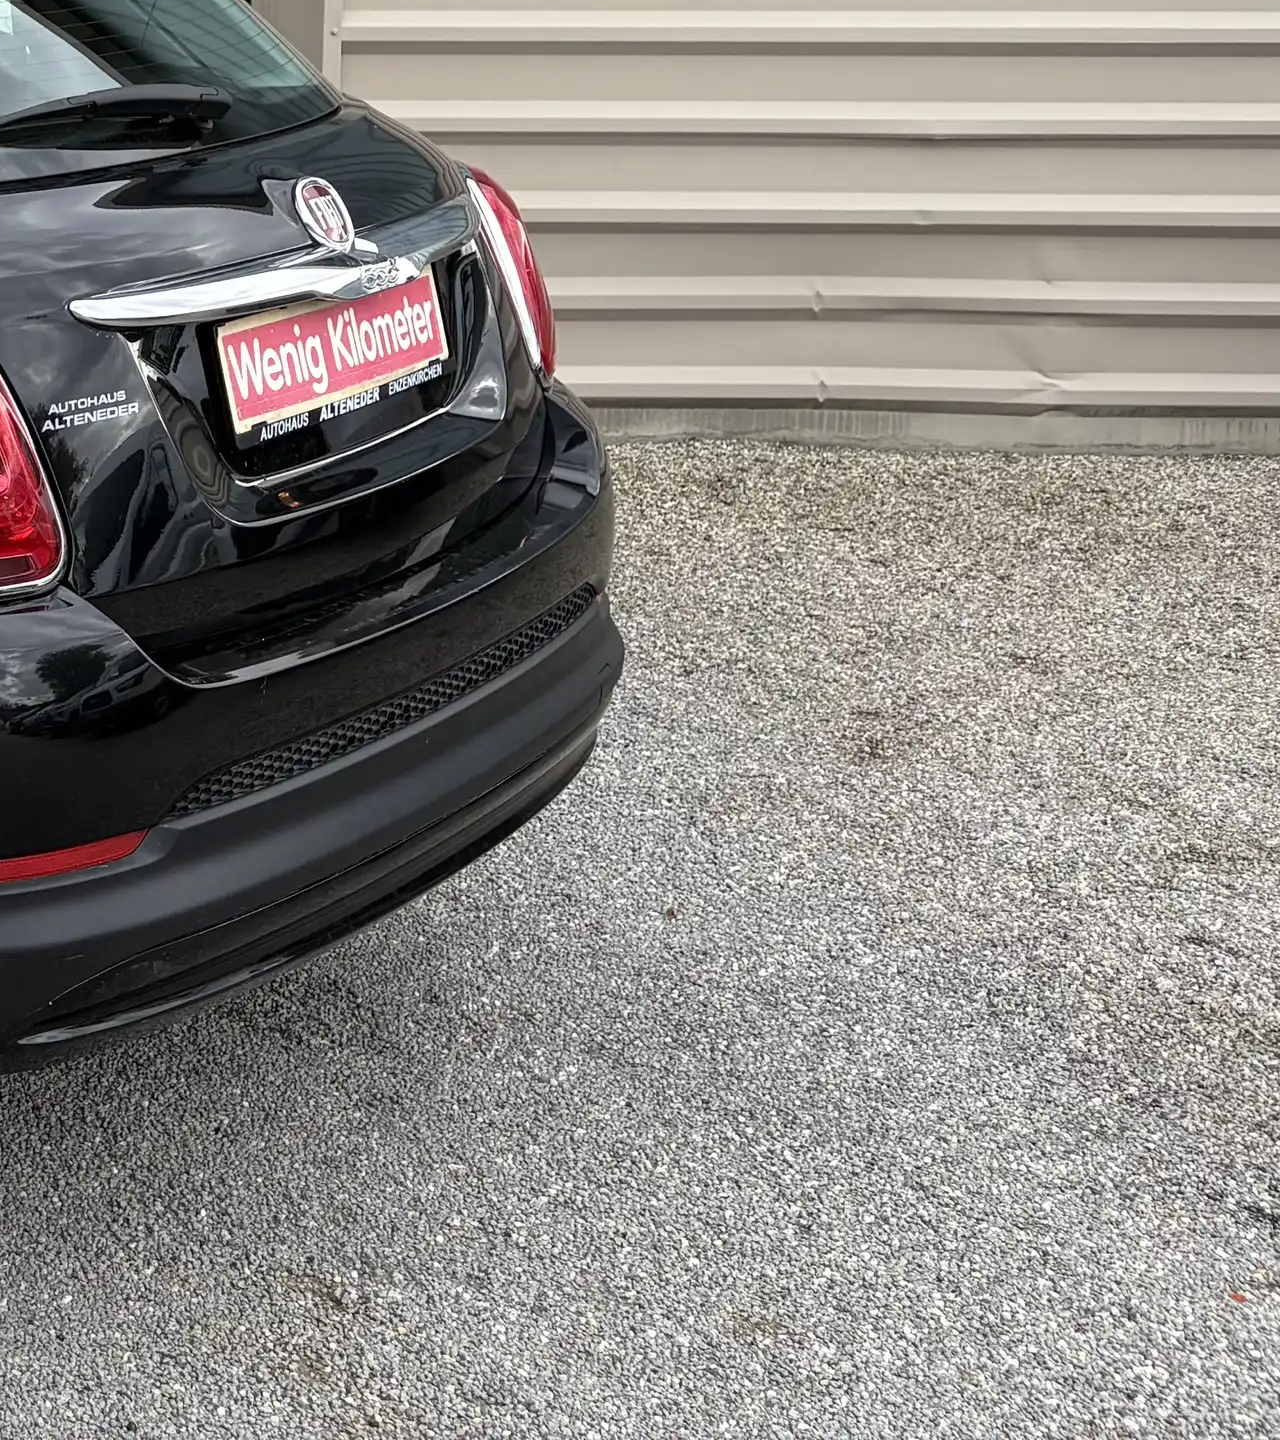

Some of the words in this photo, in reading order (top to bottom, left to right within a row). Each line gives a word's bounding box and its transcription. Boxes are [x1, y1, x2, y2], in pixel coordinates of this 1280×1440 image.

[228, 323, 329, 400] Wenig
[327, 295, 434, 372] Kilometer
[41, 402, 139, 432] ALTENEDER
[48, 390, 127, 415] AUTOHAUS
[260, 412, 310, 442] AUTOHAUS
[319, 387, 381, 422] ALTENEDER
[388, 363, 443, 396] ENZENKIRCHEN
